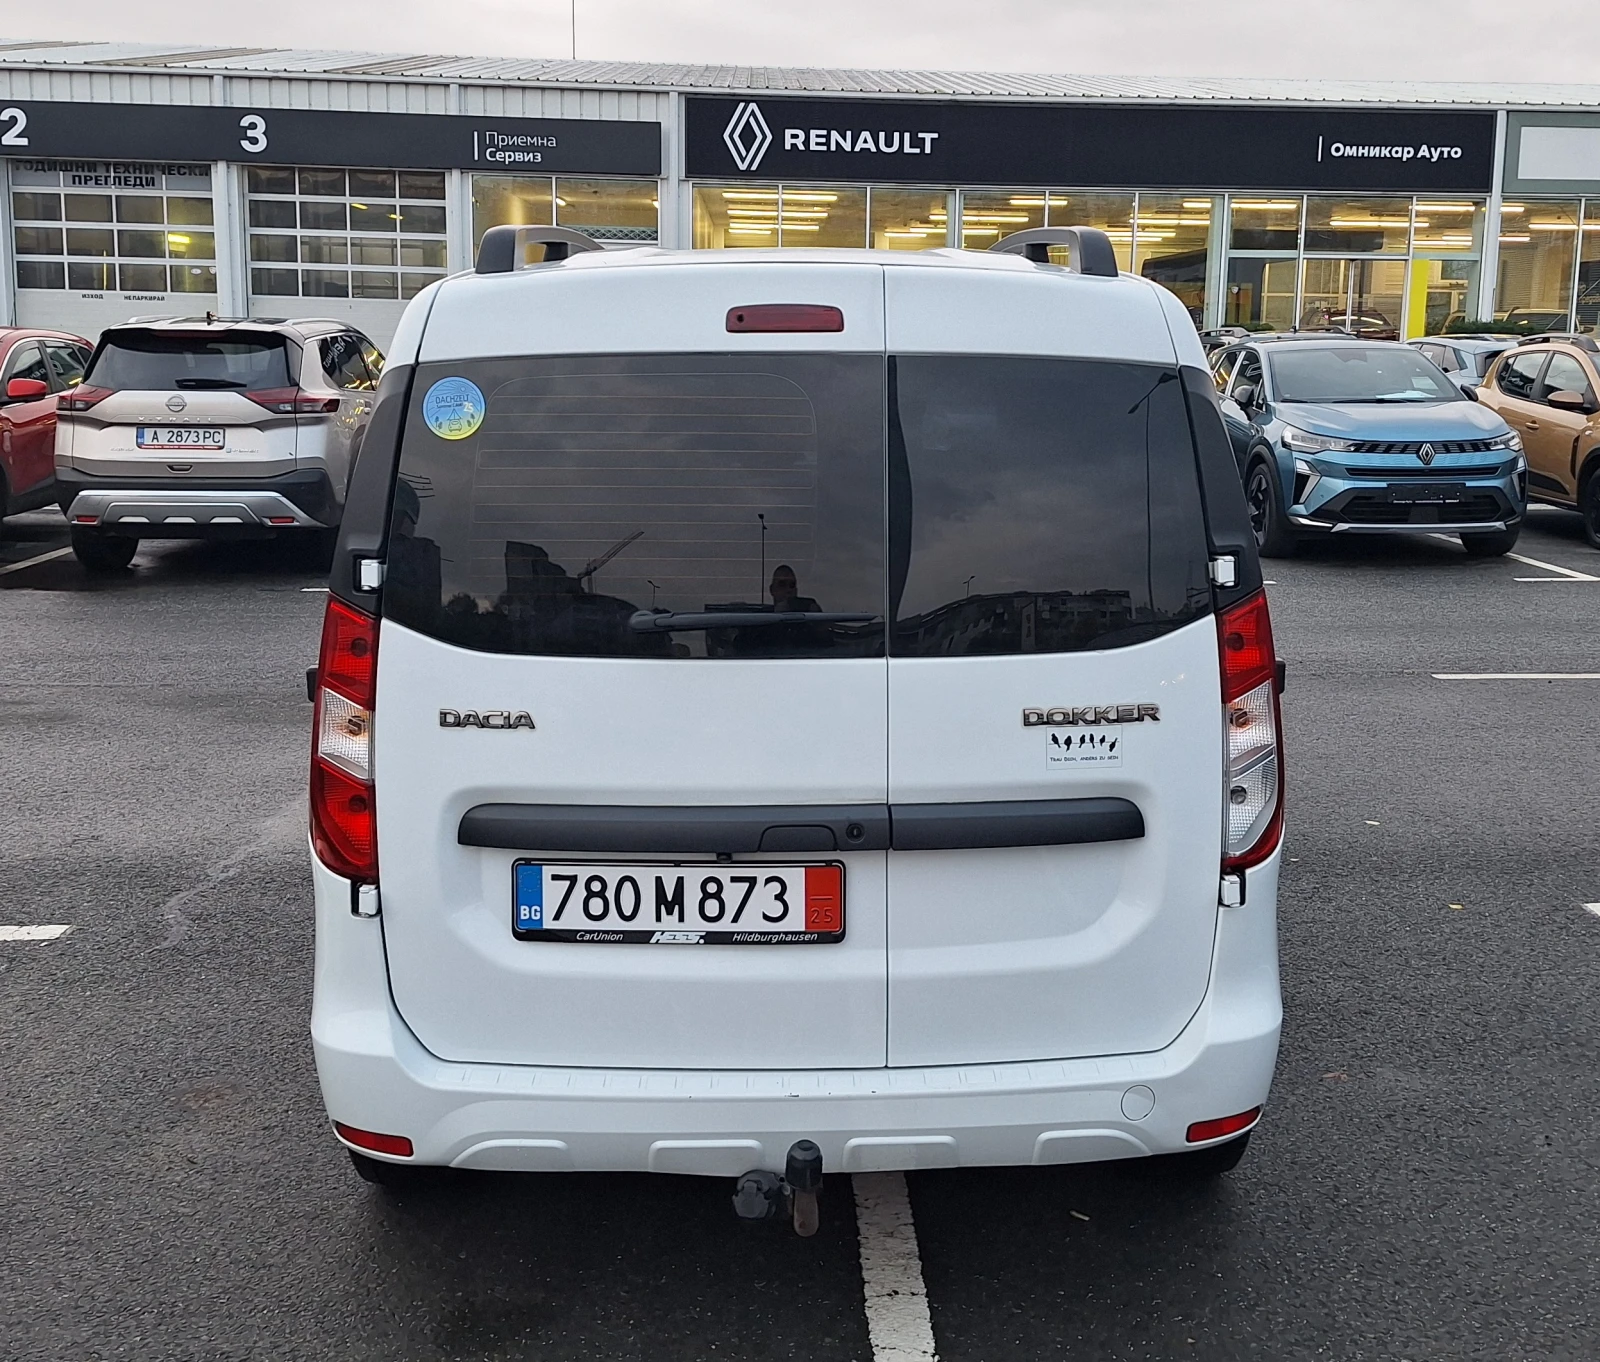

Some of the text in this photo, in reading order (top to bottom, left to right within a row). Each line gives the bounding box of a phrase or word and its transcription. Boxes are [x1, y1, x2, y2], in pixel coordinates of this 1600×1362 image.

[0, 107, 29, 146] 2
[239, 114, 268, 153] 3
[485, 131, 556, 149] Приемна
[784, 128, 939, 154] RENAULT
[485, 147, 542, 165] Сервиз
[1330, 142, 1462, 162] Омникар Ауто
[15, 160, 210, 177] ГОДИШНИ ТЕХНИЧЕСКИ
[71, 174, 156, 188] ПРЕГЛЕДИ
[435, 393, 470, 405] DACHZELT
[463, 402, 475, 413] 25
[151, 430, 160, 443] A
[166, 430, 200, 444] 2873
[439, 708, 536, 729] DACIA
[1023, 703, 1161, 727] DOKKER
[550, 874, 790, 924] 780 M 873
[520, 905, 541, 920] BG
[810, 906, 833, 924] 25
[576, 931, 624, 942] CarUnion
[732, 932, 818, 943] Hildburghausen
